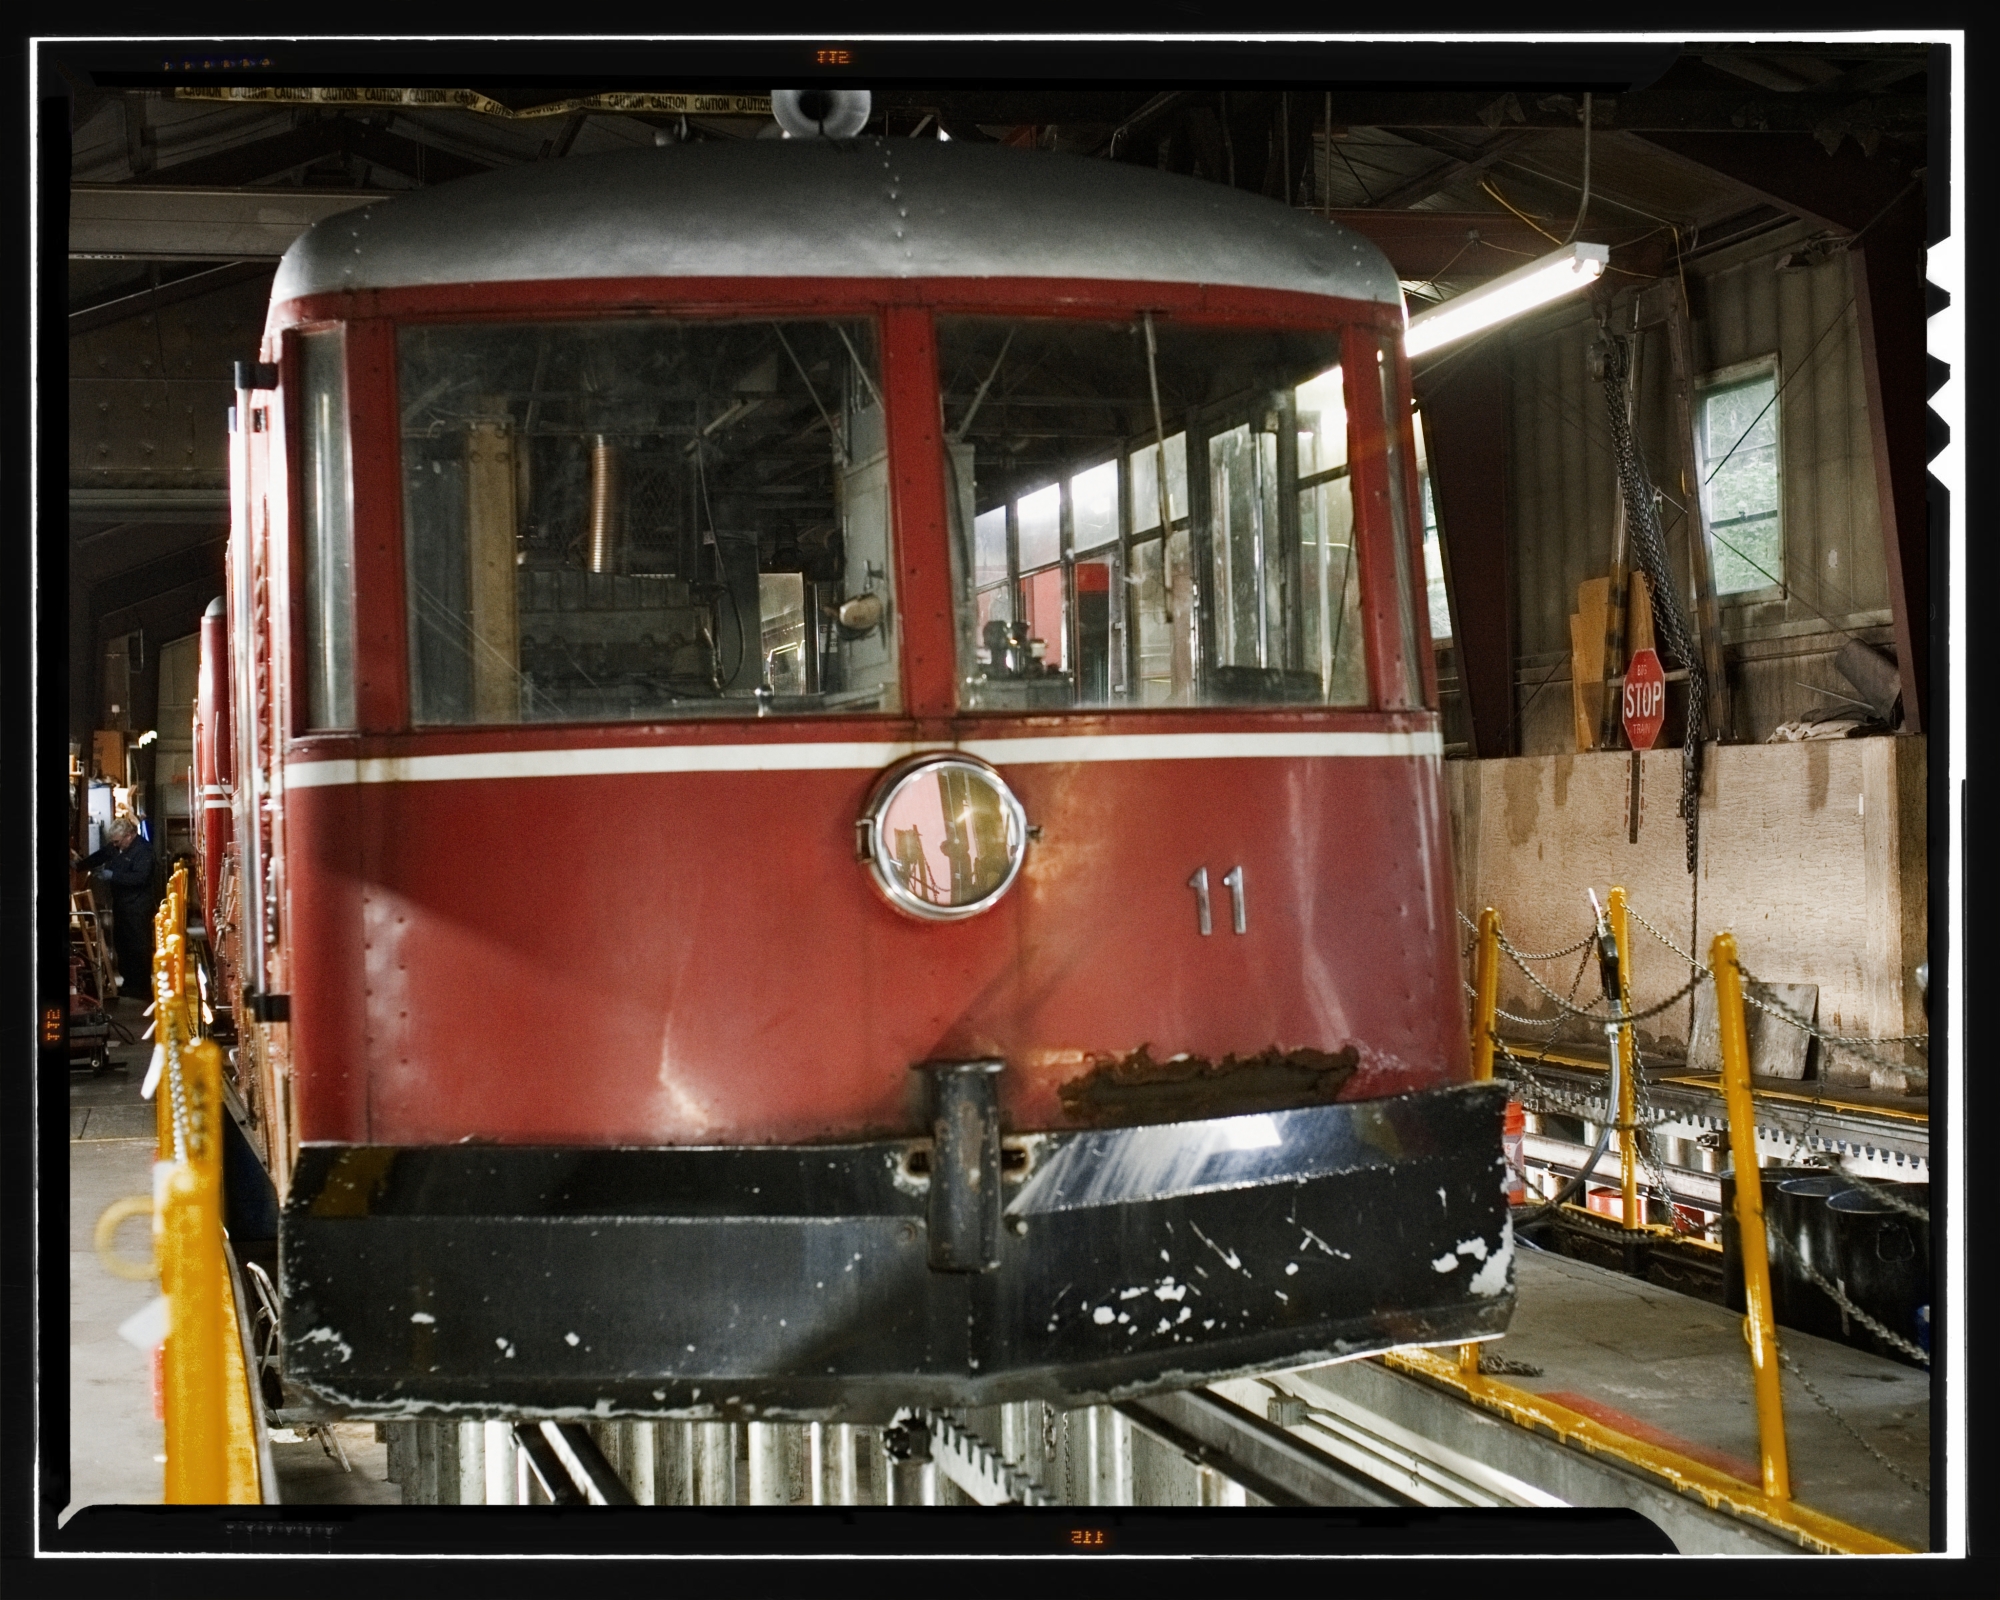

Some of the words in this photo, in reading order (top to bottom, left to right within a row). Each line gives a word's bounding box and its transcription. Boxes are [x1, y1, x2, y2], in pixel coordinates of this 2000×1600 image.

[320, 88, 358, 100] CAUTION
[364, 88, 402, 102] CAUTION
[408, 89, 447, 103] CAUTION
[608, 94, 644, 108] CAUTION
[651, 95, 688, 109] CAUTION
[695, 97, 730, 111] CAUTION
[1625, 681, 1661, 718] STOP
[1188, 865, 1247, 936] 11
